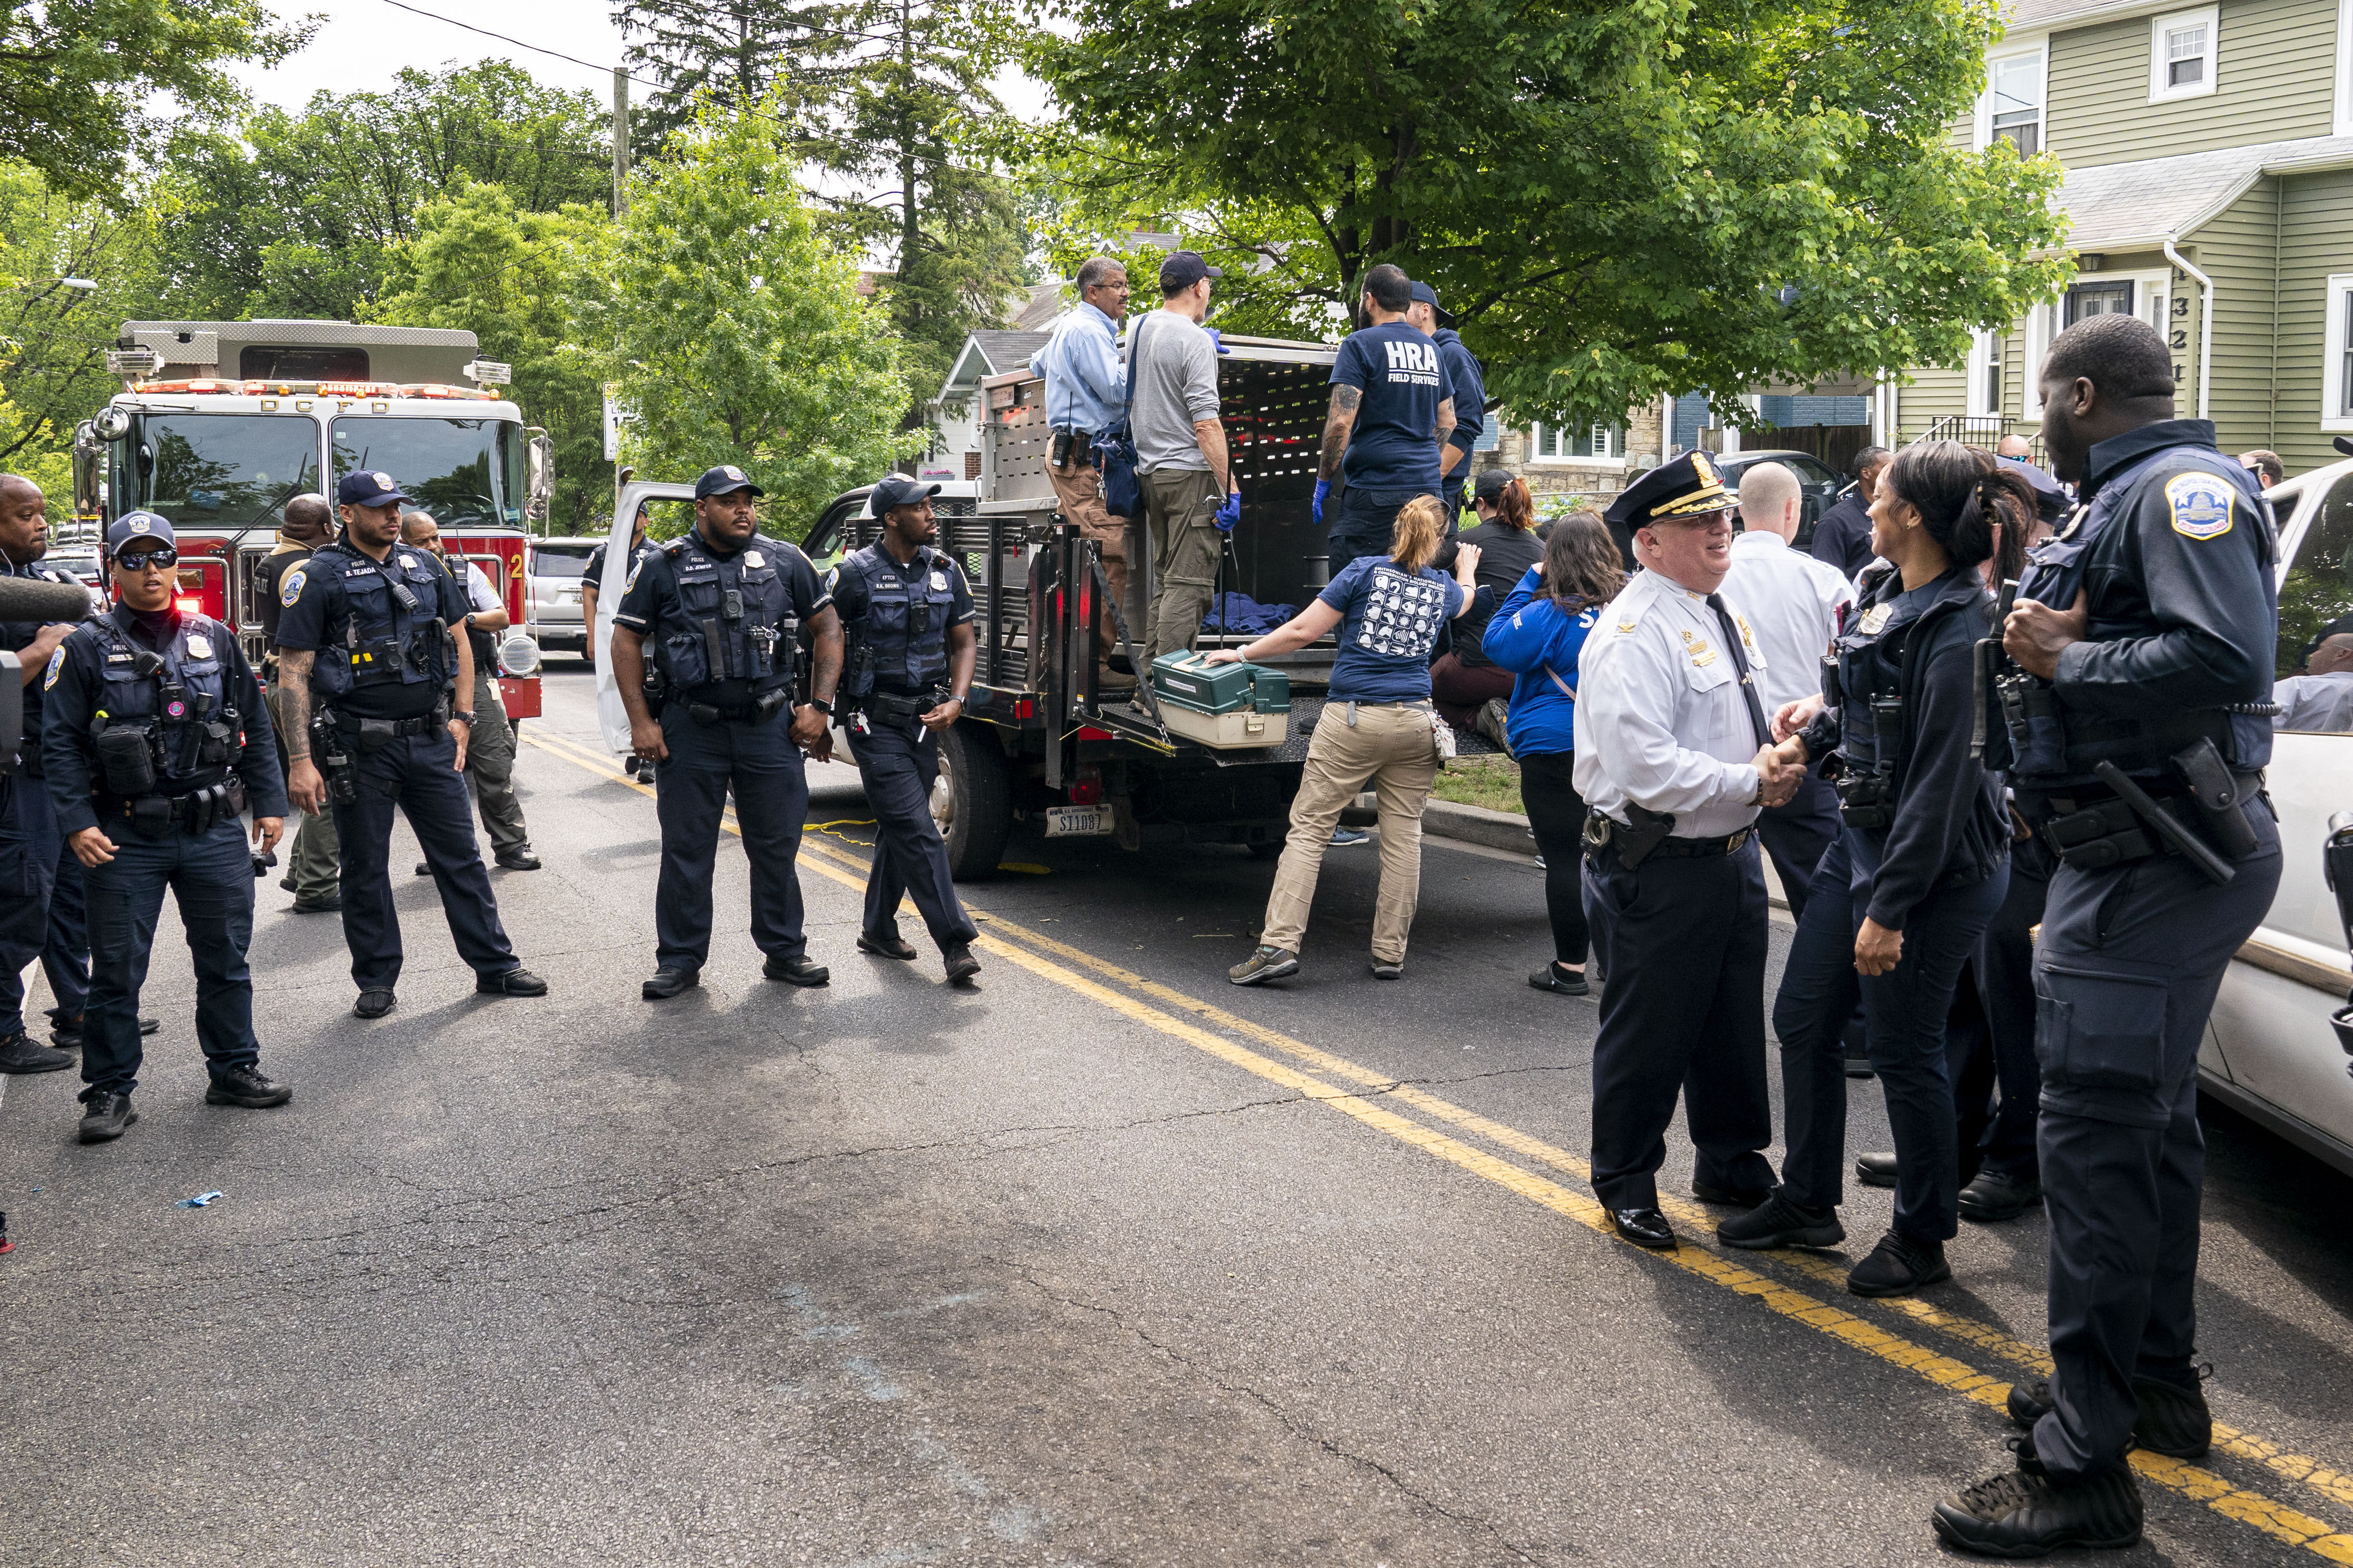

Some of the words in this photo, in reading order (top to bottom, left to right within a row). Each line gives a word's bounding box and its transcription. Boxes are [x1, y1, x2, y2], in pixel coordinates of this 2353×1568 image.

[1384, 341, 1438, 373] HRA
[1388, 373, 1410, 383] FIELD
[1411, 374, 1439, 386] SERVICES
[352, 567, 376, 576] TEJADA
[509, 554, 522, 579] 2
[1374, 566, 1412, 579] SMITHSONIAN'S
[1378, 571, 1409, 582] CONSERVATION
[1409, 579, 1428, 588] BIOLOGY
[1428, 583, 1446, 592] INSTITUTE
[1060, 813, 1101, 832] SI1087
